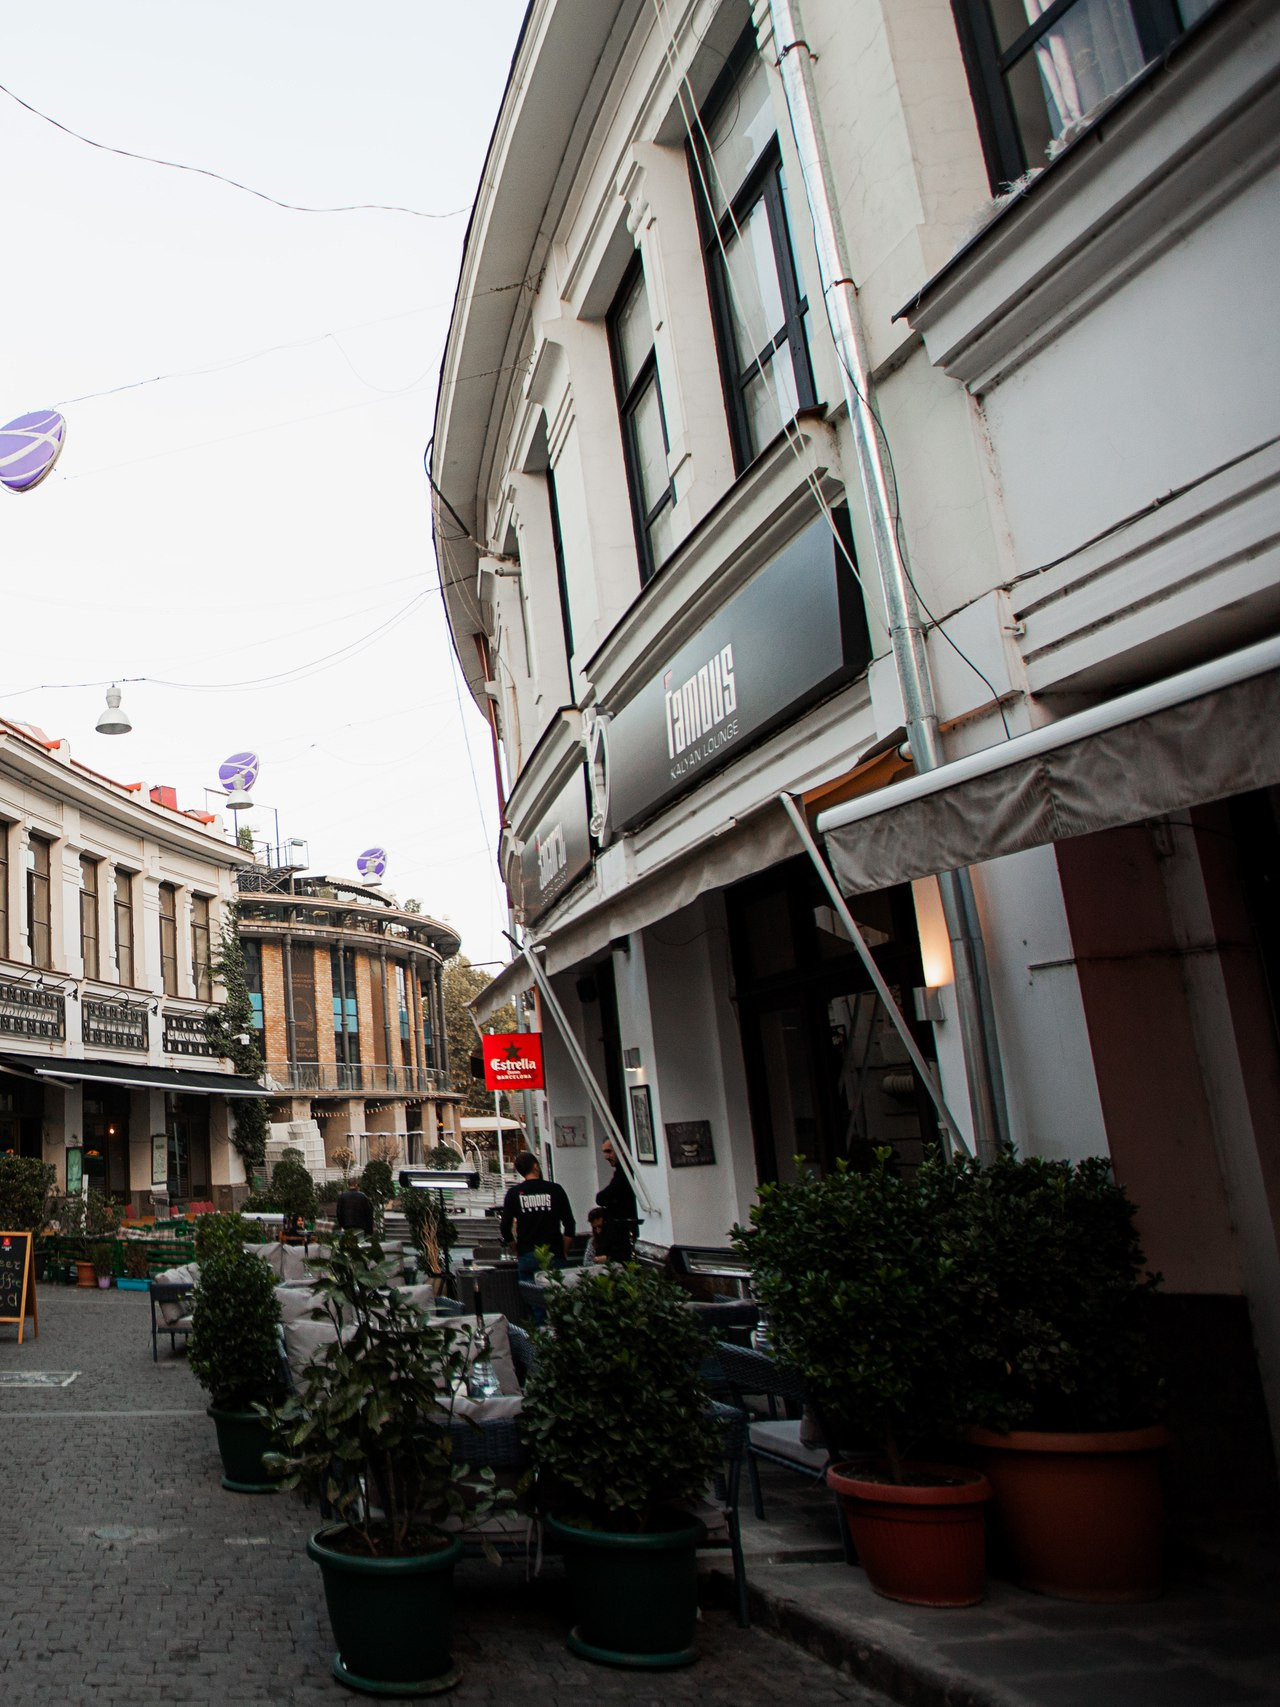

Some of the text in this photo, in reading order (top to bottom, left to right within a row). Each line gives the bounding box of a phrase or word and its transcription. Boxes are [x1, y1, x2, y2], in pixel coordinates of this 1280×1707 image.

[664, 643, 737, 760] famous
[670, 719, 739, 780] KALYAN LOUNGE
[490, 1058, 536, 1071] Estrella
[519, 1190, 552, 1209] famous
